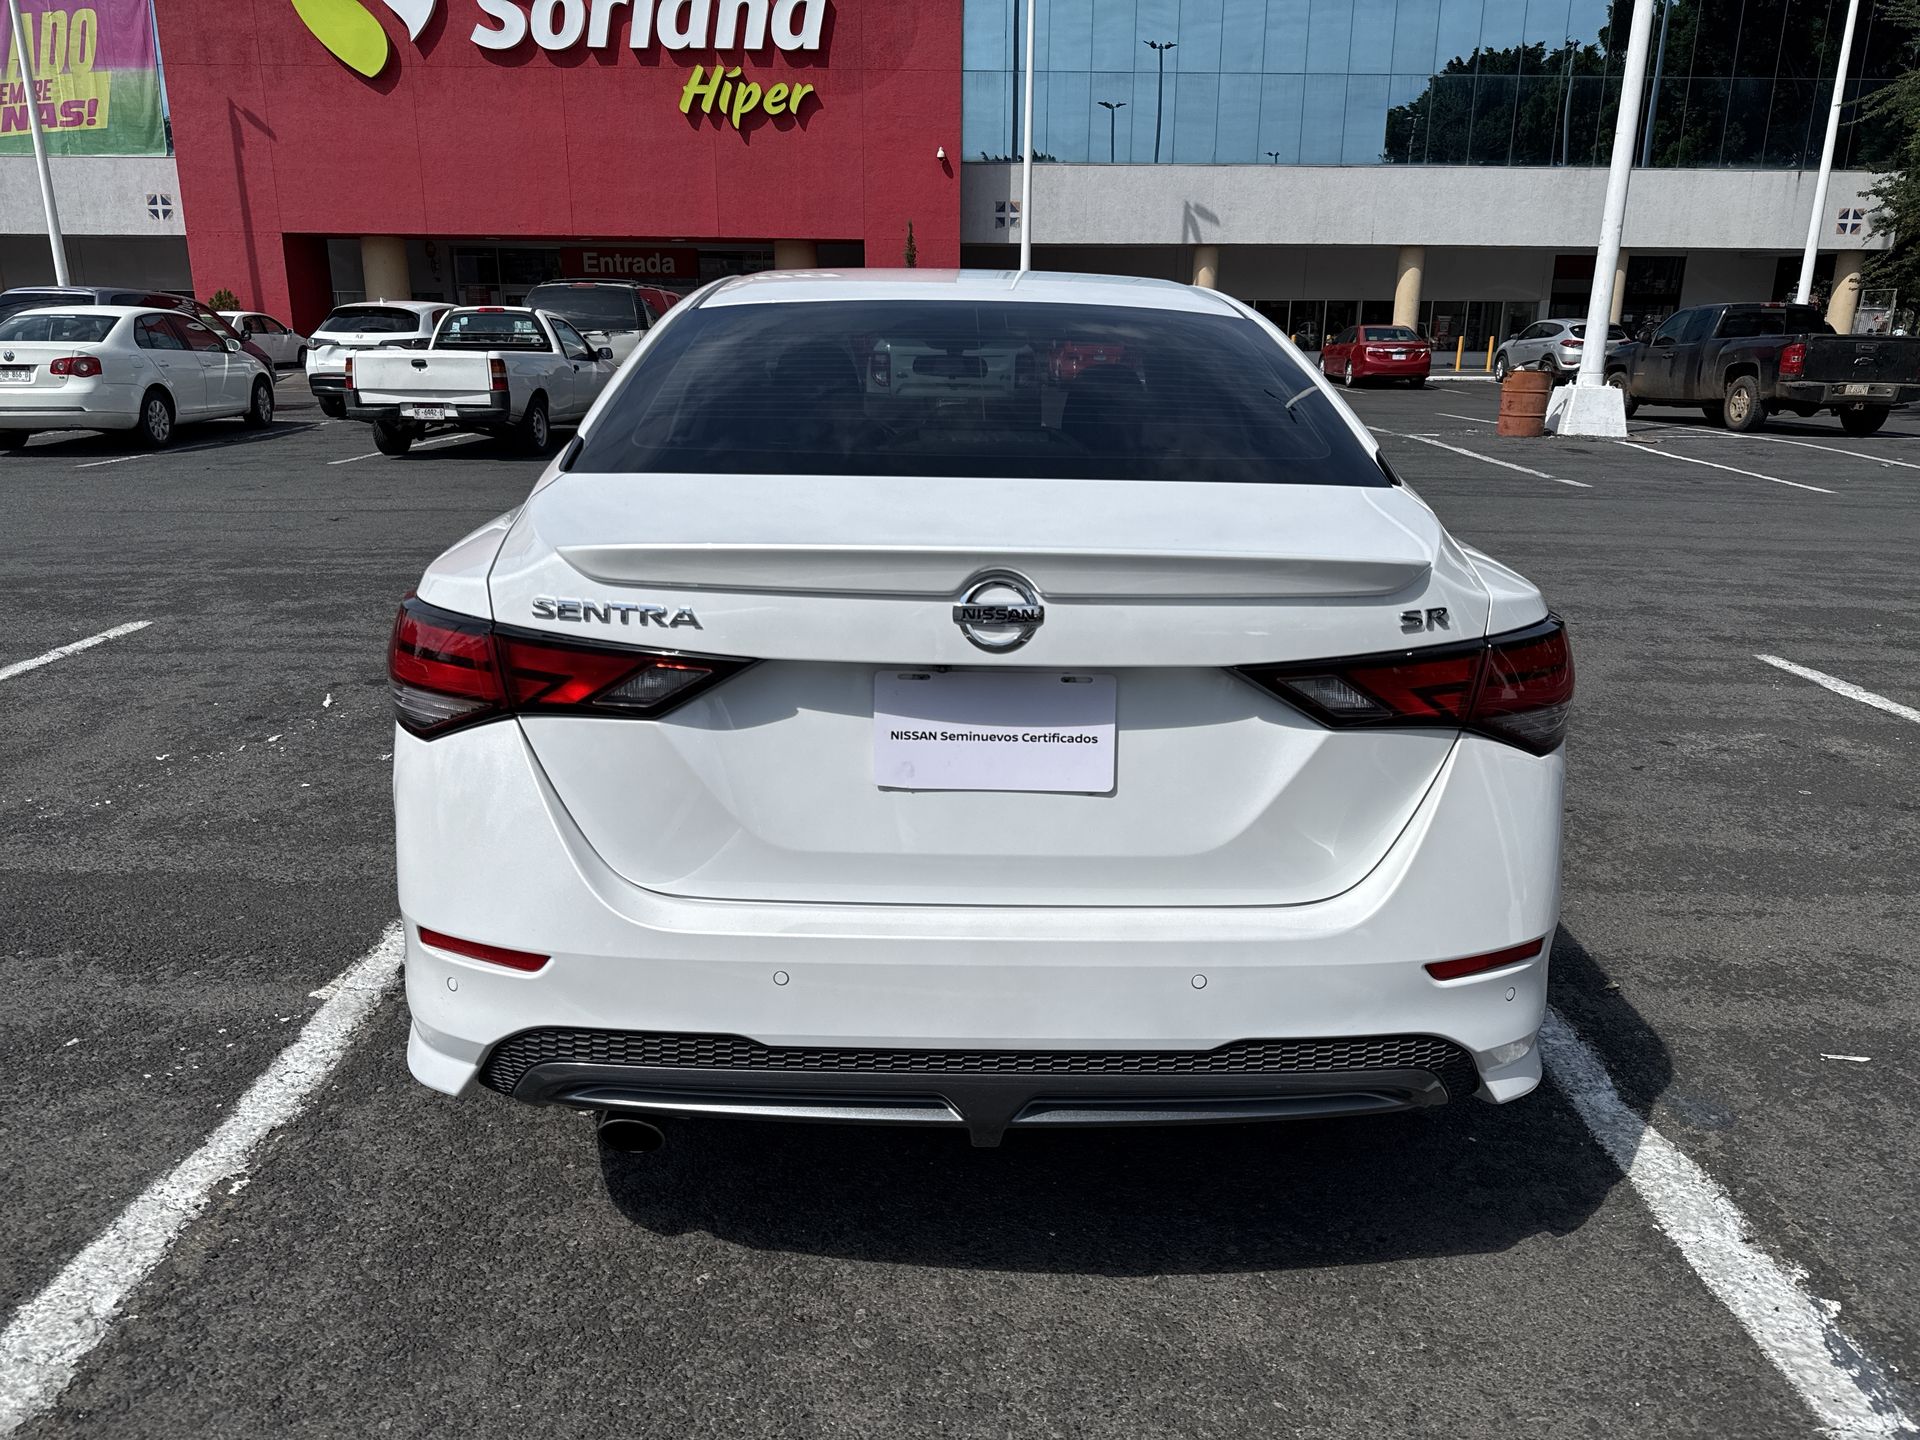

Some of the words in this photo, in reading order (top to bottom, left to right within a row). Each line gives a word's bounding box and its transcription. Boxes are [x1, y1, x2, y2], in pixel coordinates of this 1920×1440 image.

[470, 0, 826, 50] Soriana
[679, 64, 814, 129] Híper
[582, 252, 676, 274] Entrada
[532, 595, 703, 630] SENTRA
[962, 608, 1035, 621] NISSAN
[1400, 607, 1450, 635] SR
[890, 731, 937, 742] NISSAN
[940, 731, 1019, 744] Seminuevos
[1021, 732, 1099, 745] Certificados
